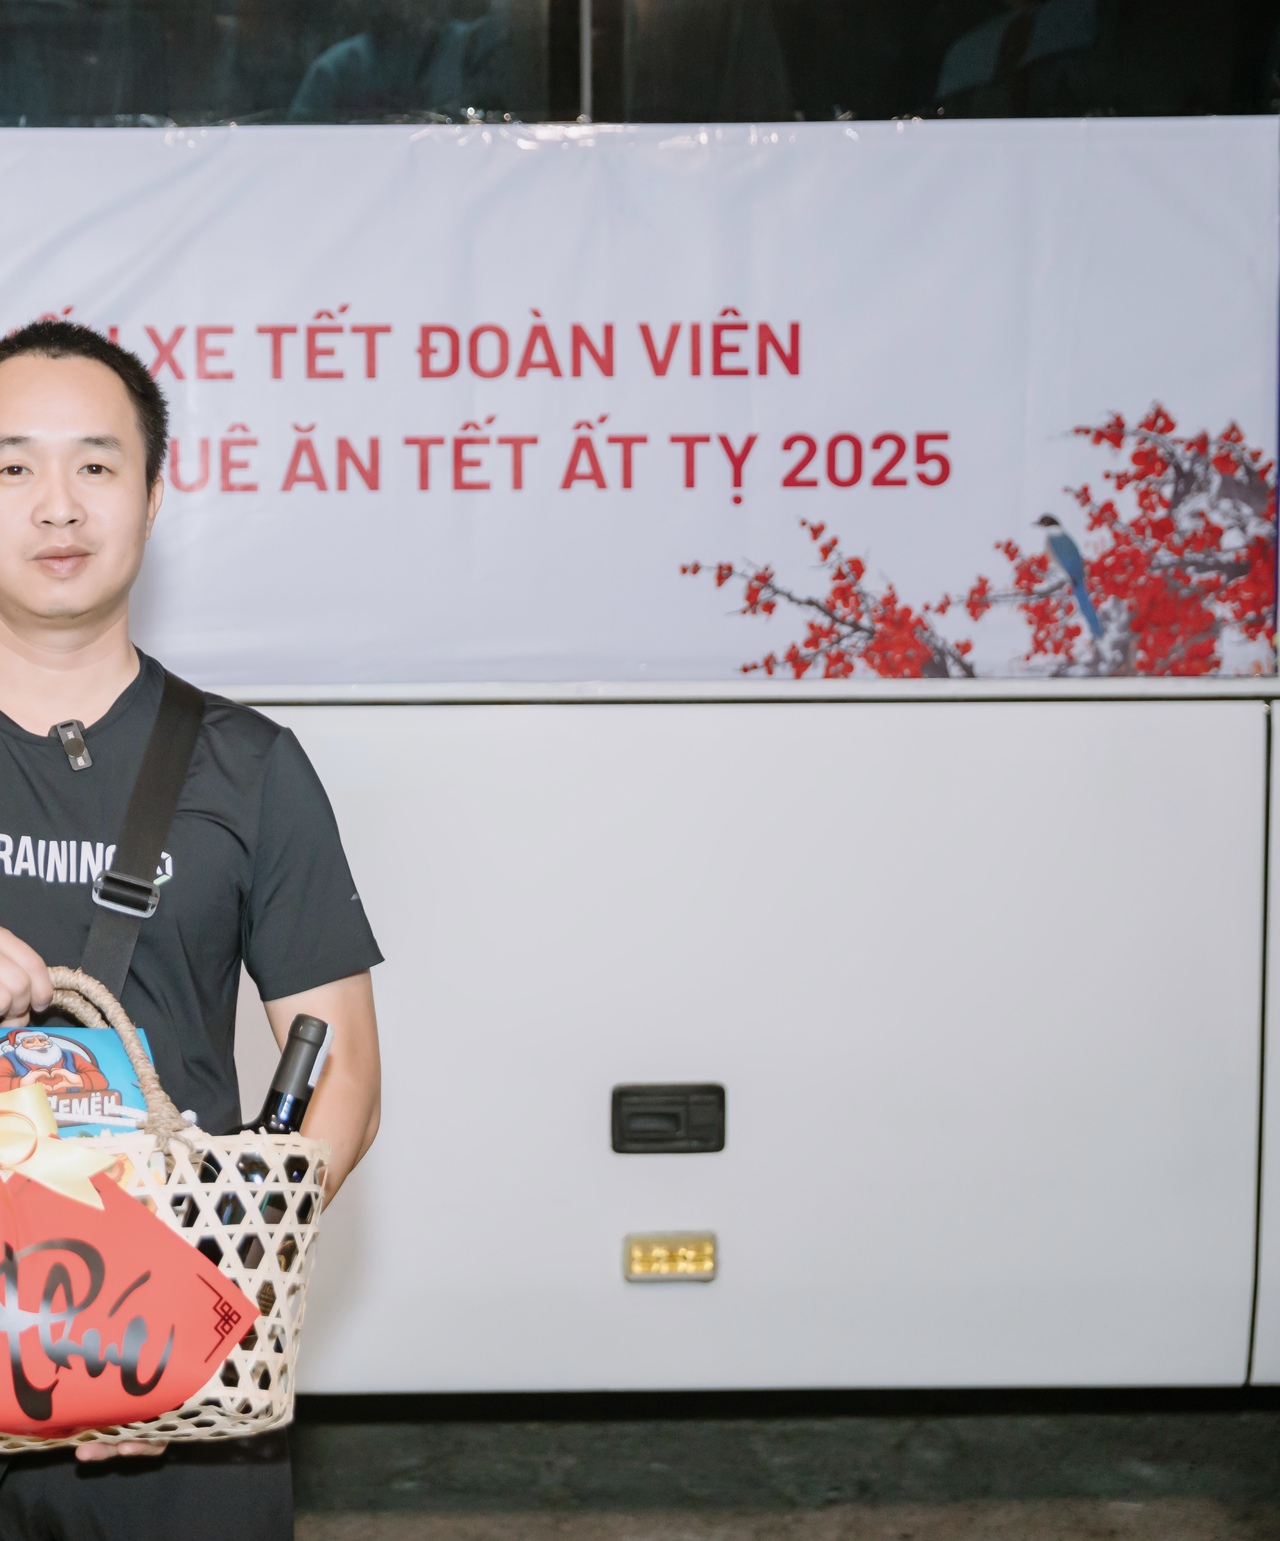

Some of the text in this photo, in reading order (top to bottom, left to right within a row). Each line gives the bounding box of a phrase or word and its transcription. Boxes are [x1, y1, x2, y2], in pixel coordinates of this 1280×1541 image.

[144, 325, 236, 381] XE
[255, 303, 393, 381] TẾT
[415, 308, 616, 380] ĐOÀN
[637, 307, 803, 378] VIÊN
[169, 422, 260, 493] UÊ
[280, 424, 381, 493] ĂN
[402, 414, 540, 492] TẾT
[560, 413, 649, 491] ẤT
[669, 433, 759, 506] TỴ
[780, 431, 953, 489] 2025
